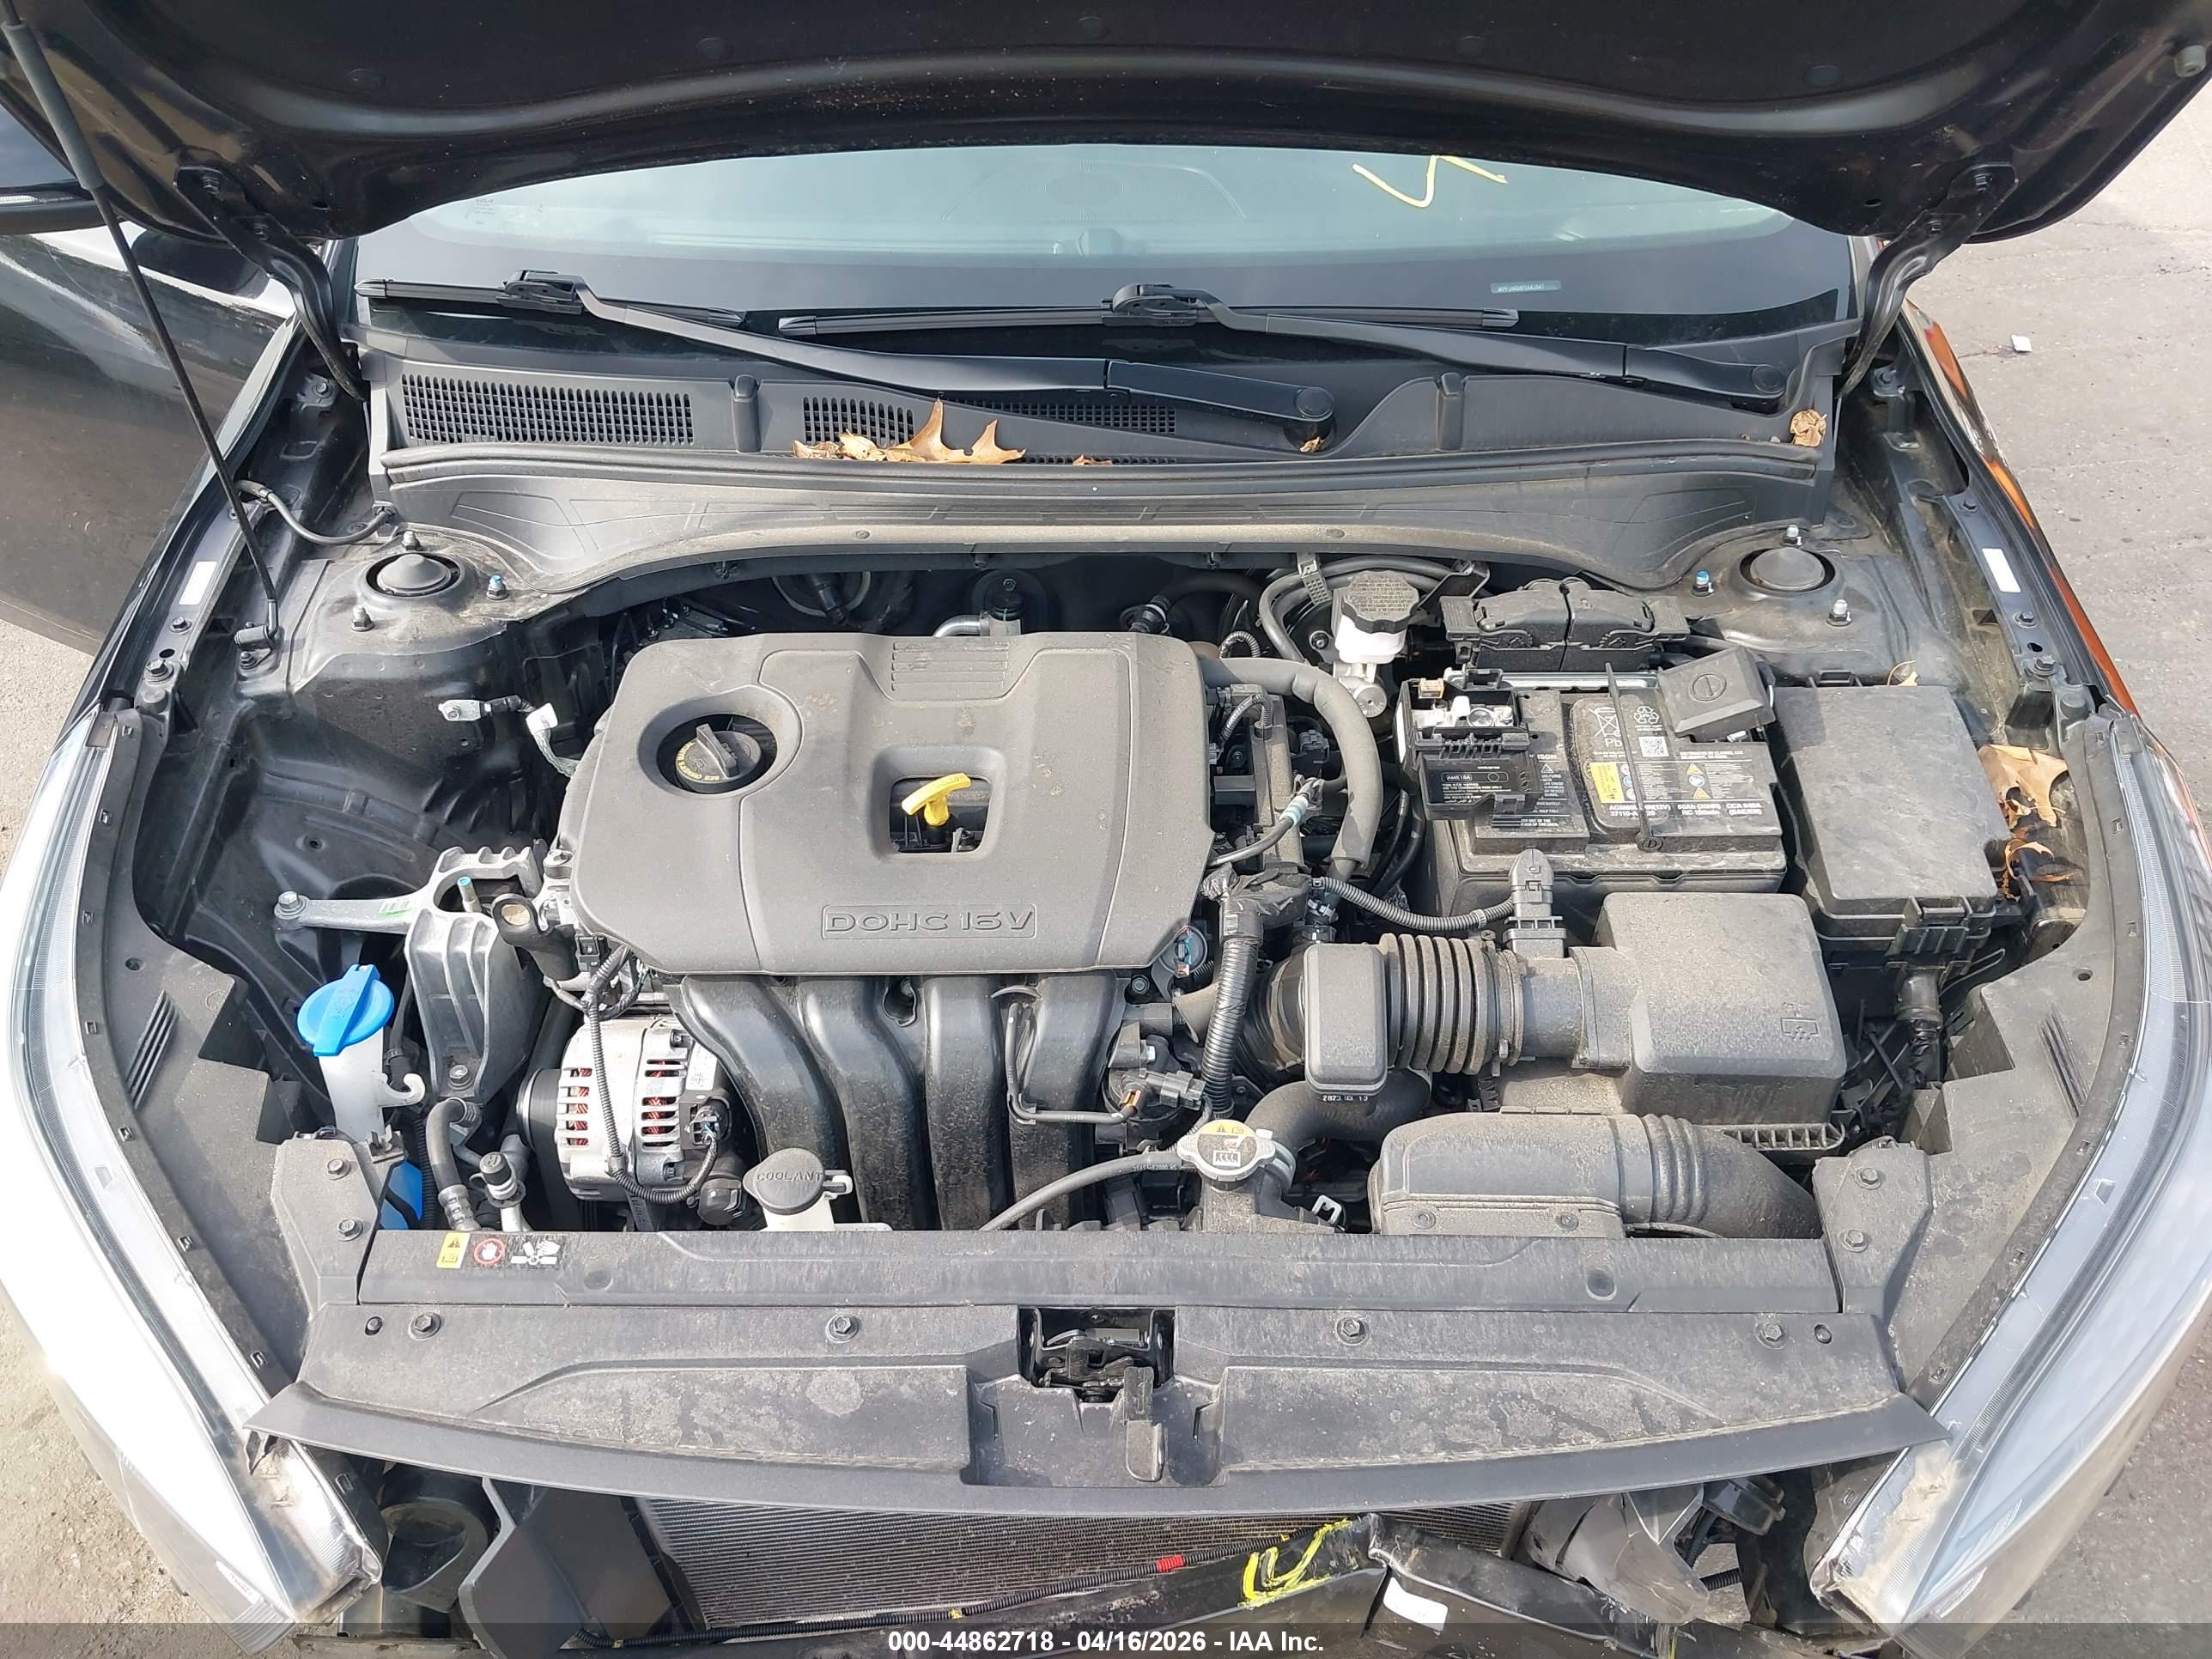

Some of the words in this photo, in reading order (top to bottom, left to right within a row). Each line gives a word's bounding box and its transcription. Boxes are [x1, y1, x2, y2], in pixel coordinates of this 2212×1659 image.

[1604, 738, 1623, 747] Pb
[825, 912, 949, 933] DOHC
[959, 911, 1033, 931] 16V
[757, 1170, 823, 1182] COOLANT
